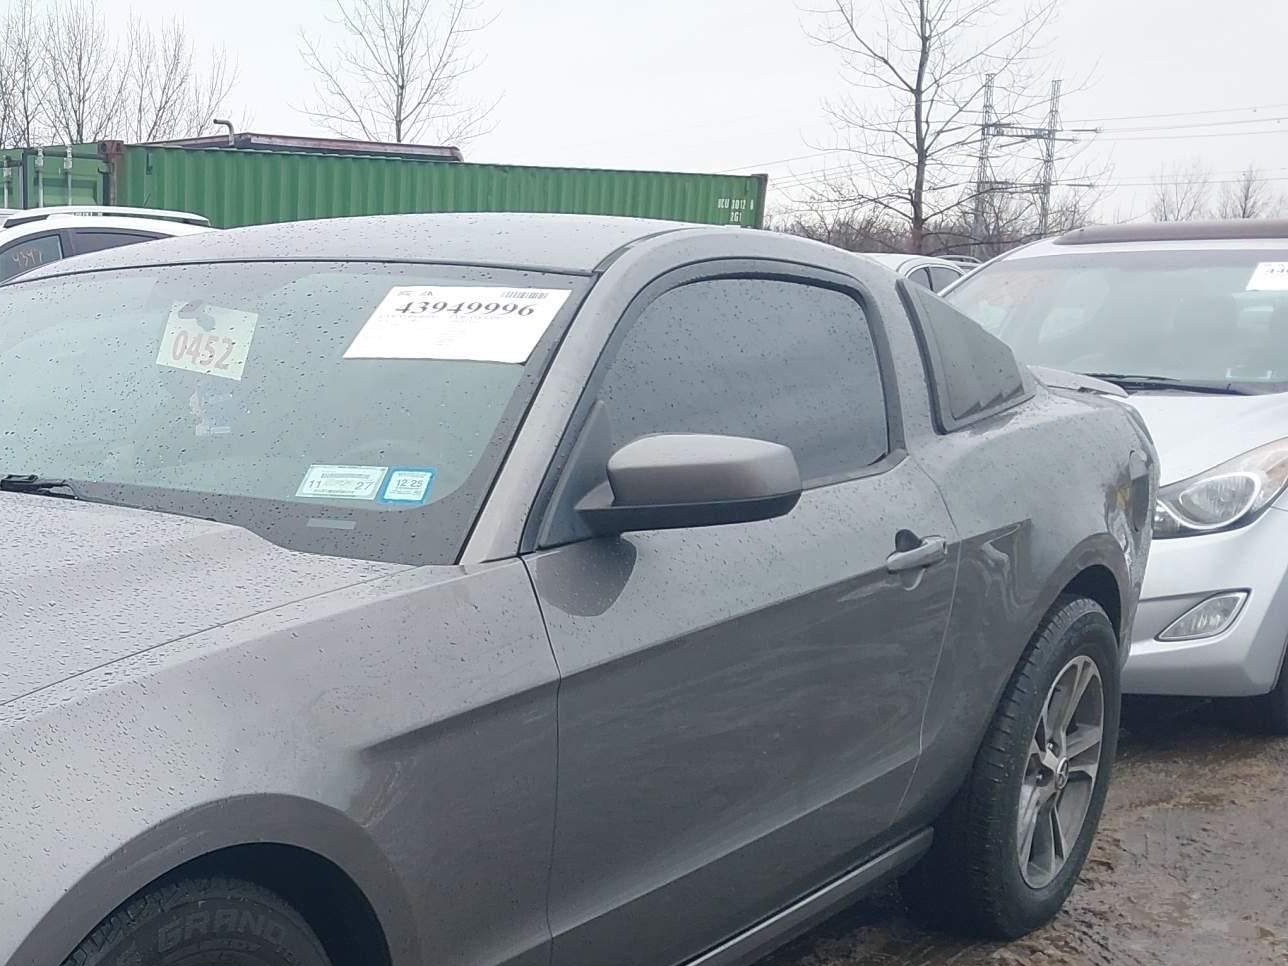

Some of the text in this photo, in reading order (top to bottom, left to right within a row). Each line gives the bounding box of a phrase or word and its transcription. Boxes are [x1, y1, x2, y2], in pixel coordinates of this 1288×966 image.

[395, 300, 537, 317] 43949996
[172, 330, 233, 370] 0452
[354, 481, 376, 491] 27
[157, 908, 289, 953] GRAND
